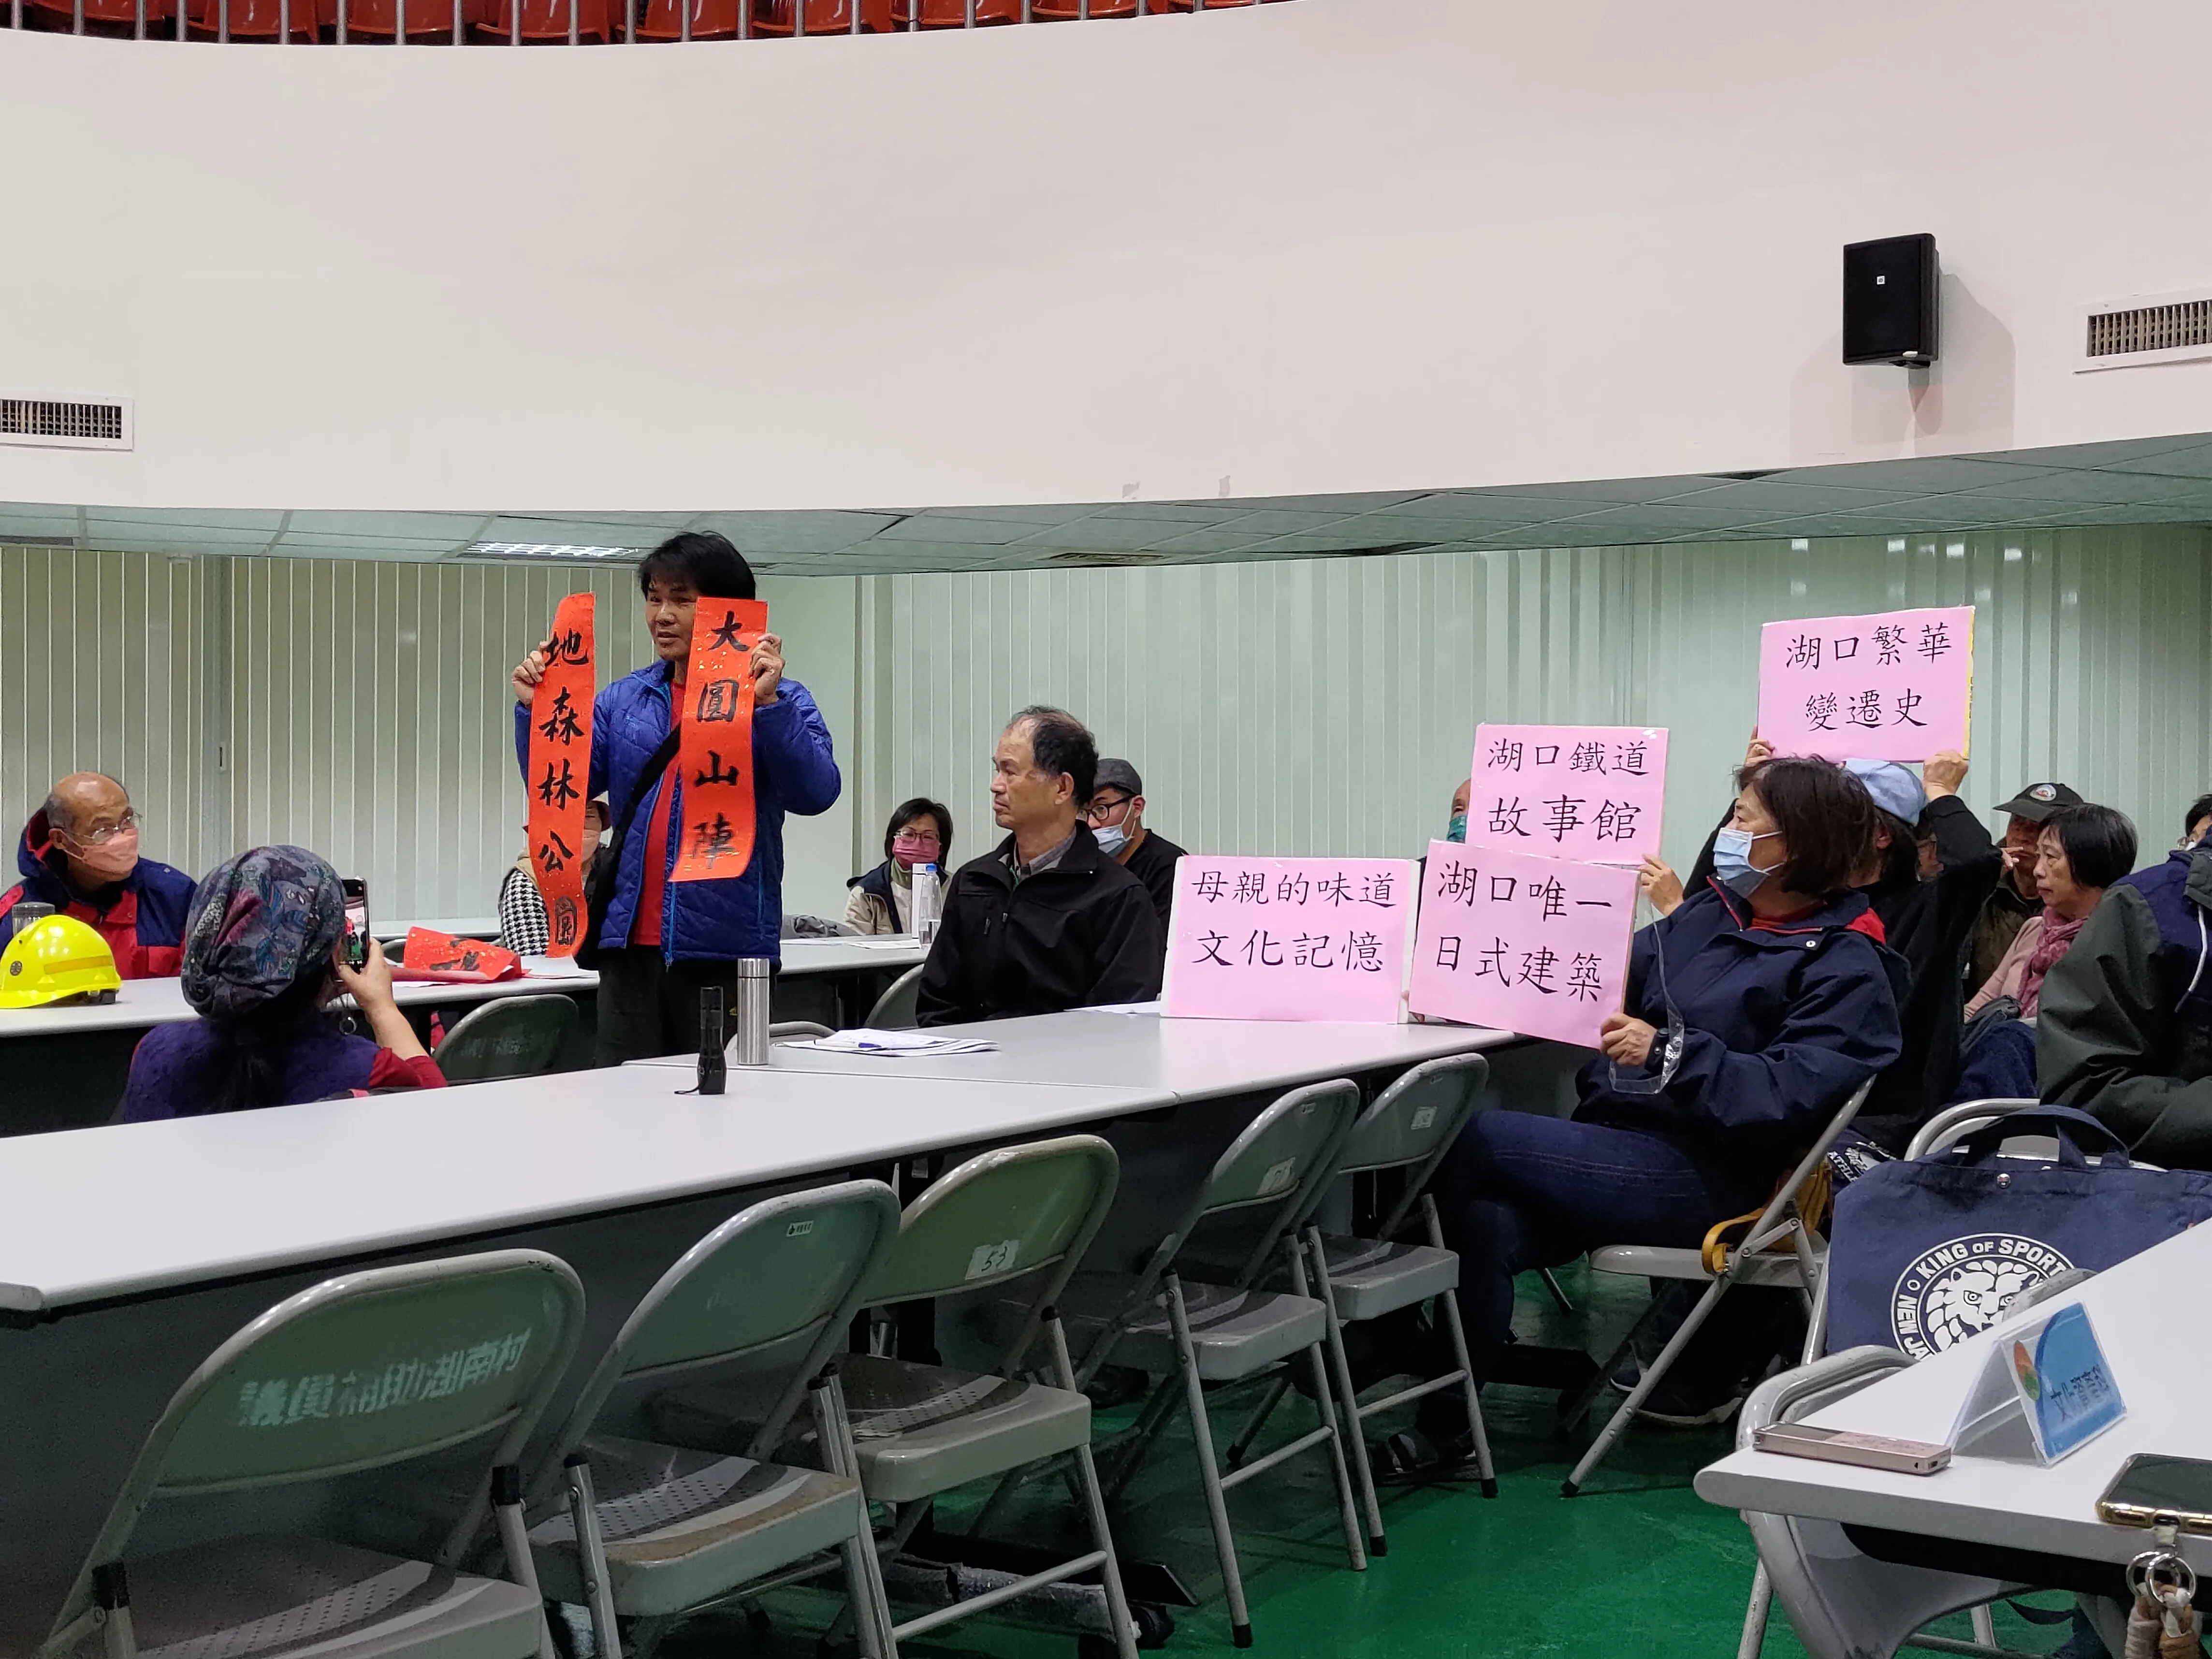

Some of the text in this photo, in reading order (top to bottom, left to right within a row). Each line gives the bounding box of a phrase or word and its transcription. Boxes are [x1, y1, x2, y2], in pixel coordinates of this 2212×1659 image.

[1786, 621, 1952, 670] 湖口繁華
[1805, 687, 1928, 732] 變遷史
[1487, 738, 1649, 777] 湖口鐵道
[1488, 793, 1642, 843] 故事館
[1191, 871, 1397, 909] 母親的味道
[1437, 860, 1613, 921] 湖口唯一
[1192, 928, 1383, 973] 文化記憶
[1435, 936, 1602, 1003] 日式建築
[1916, 1243, 1968, 1279] KING
[1972, 1241, 1994, 1253] OF
[1897, 1294, 1919, 1334] NEW
